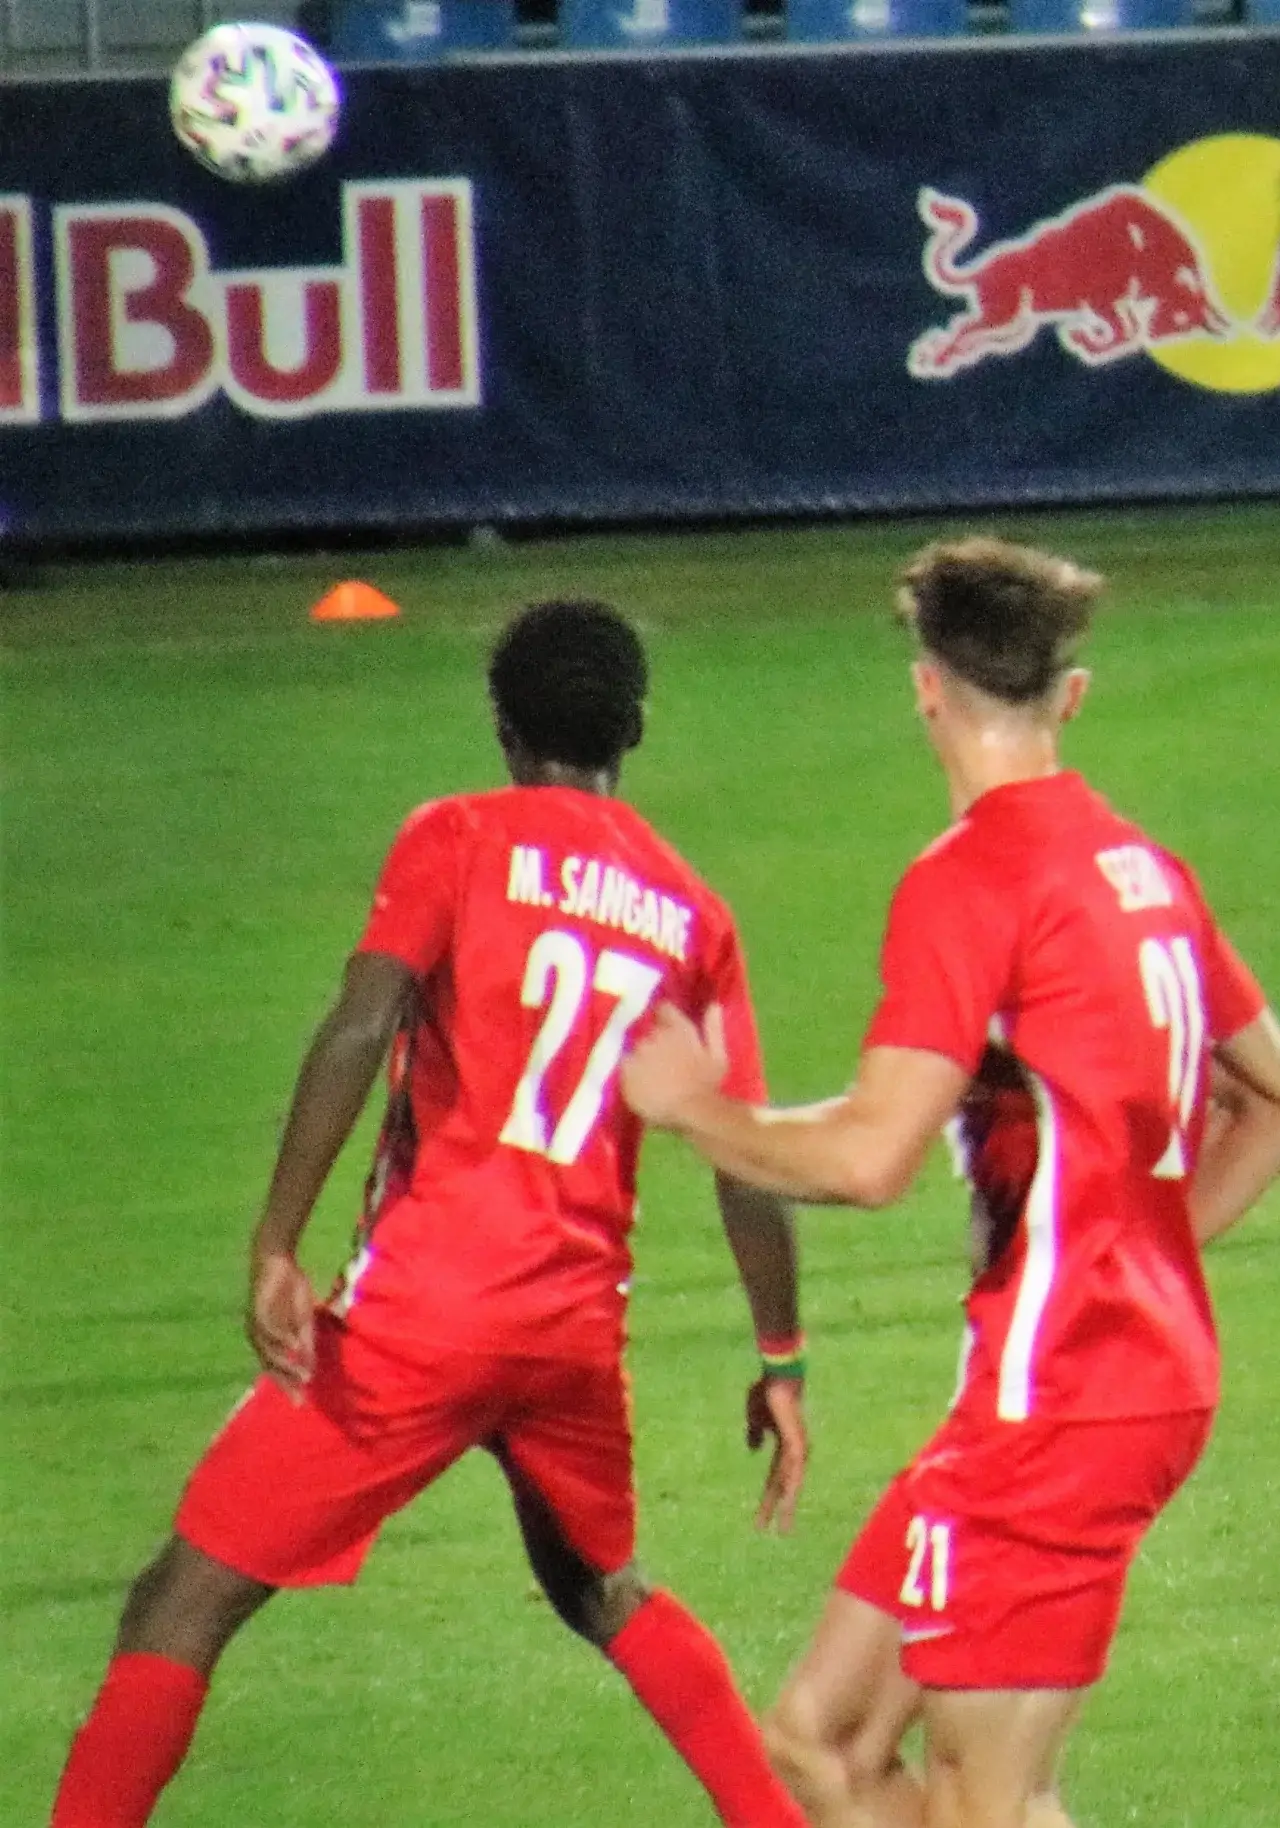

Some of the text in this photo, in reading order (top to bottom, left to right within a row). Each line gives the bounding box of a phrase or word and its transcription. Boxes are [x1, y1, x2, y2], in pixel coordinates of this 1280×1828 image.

[56, 179, 479, 419] Bull
[507, 845, 552, 906] M.
[499, 929, 664, 1166] 27
[1138, 937, 1202, 1180] 21
[899, 1515, 949, 1611] 21
